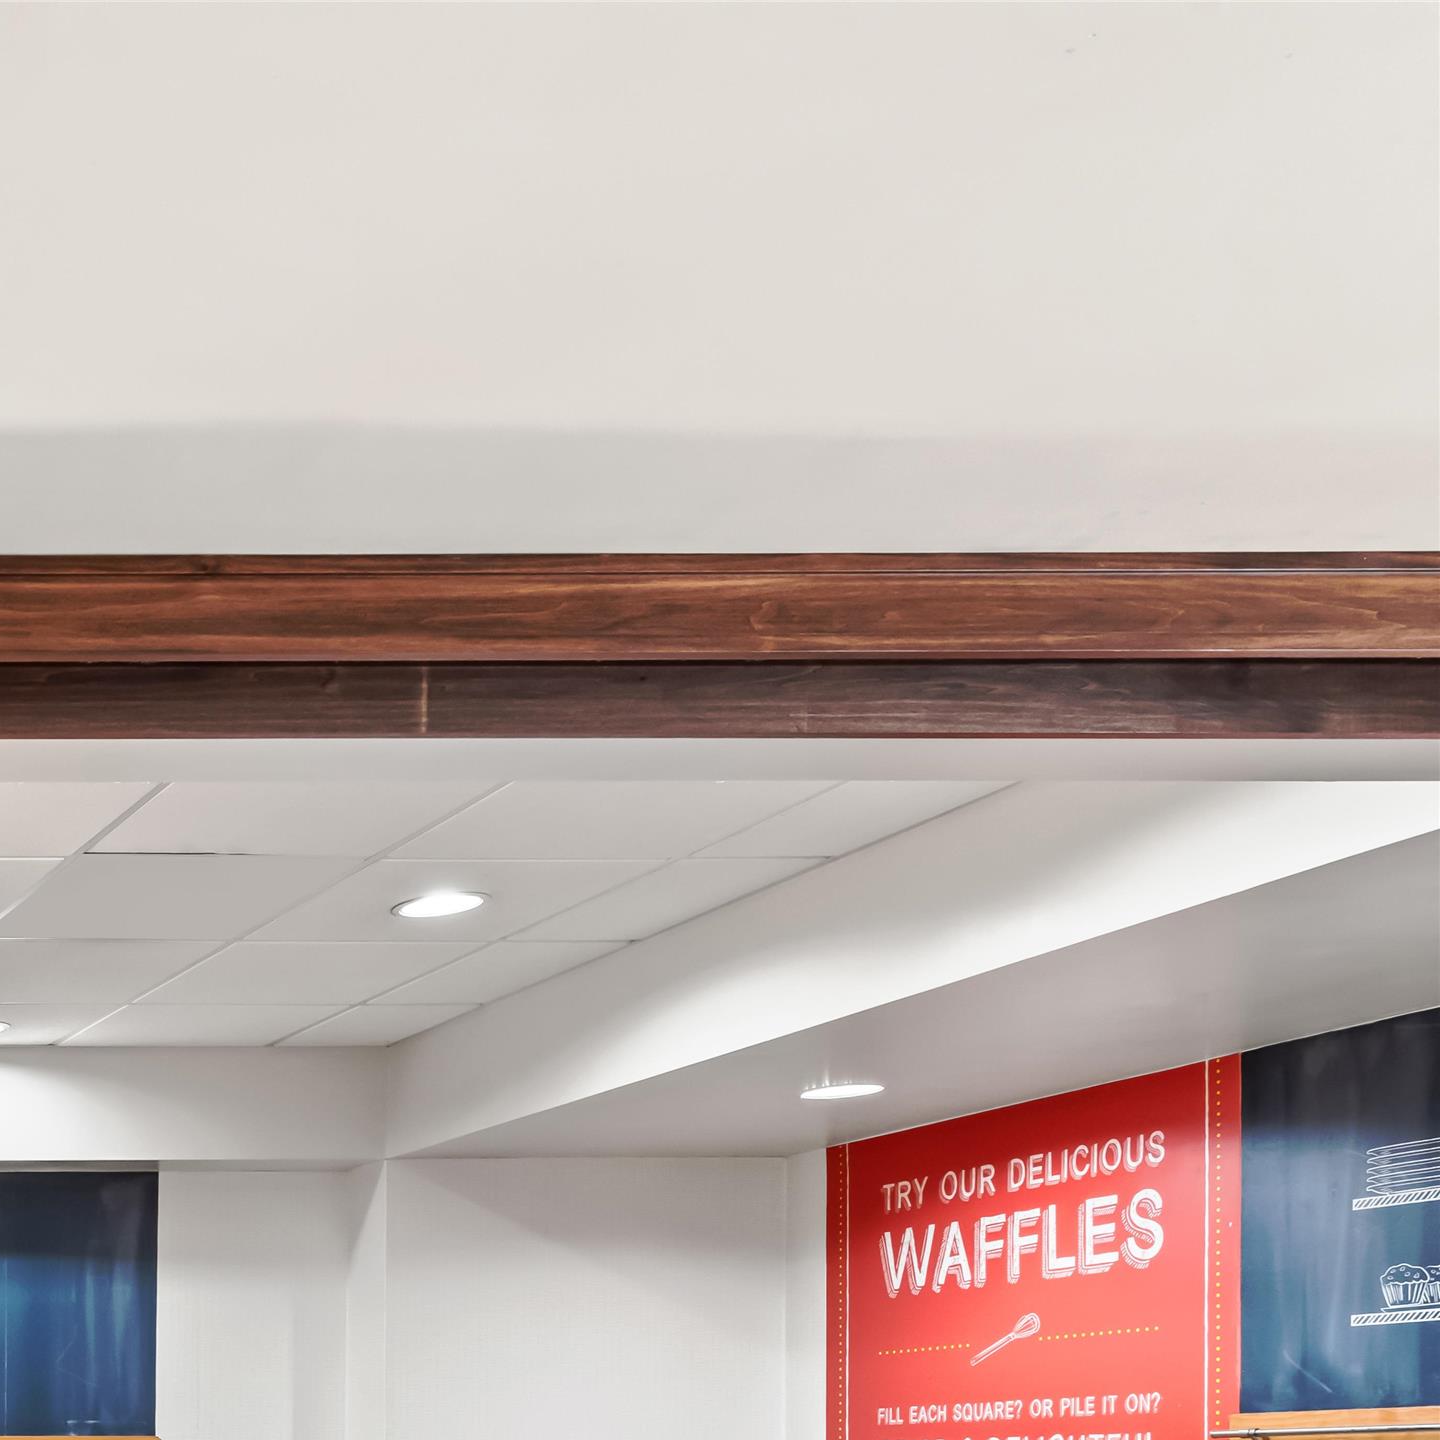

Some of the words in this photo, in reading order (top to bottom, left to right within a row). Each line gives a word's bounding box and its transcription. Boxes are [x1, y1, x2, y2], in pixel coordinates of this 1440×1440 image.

[881, 1176, 928, 1214] TRY
[939, 1164, 996, 1204] OUR
[1007, 1130, 1166, 1193] DELICIOUS
[880, 1188, 1164, 1299] WAFFLES
[877, 1408, 904, 1425] FILL
[909, 1405, 947, 1424] EACH
[952, 1400, 1023, 1422] SQUARE?
[1029, 1399, 1053, 1418] OR
[1059, 1396, 1095, 1417] PILE
[1102, 1395, 1117, 1414] IT
[1125, 1392, 1161, 1414] ON?
